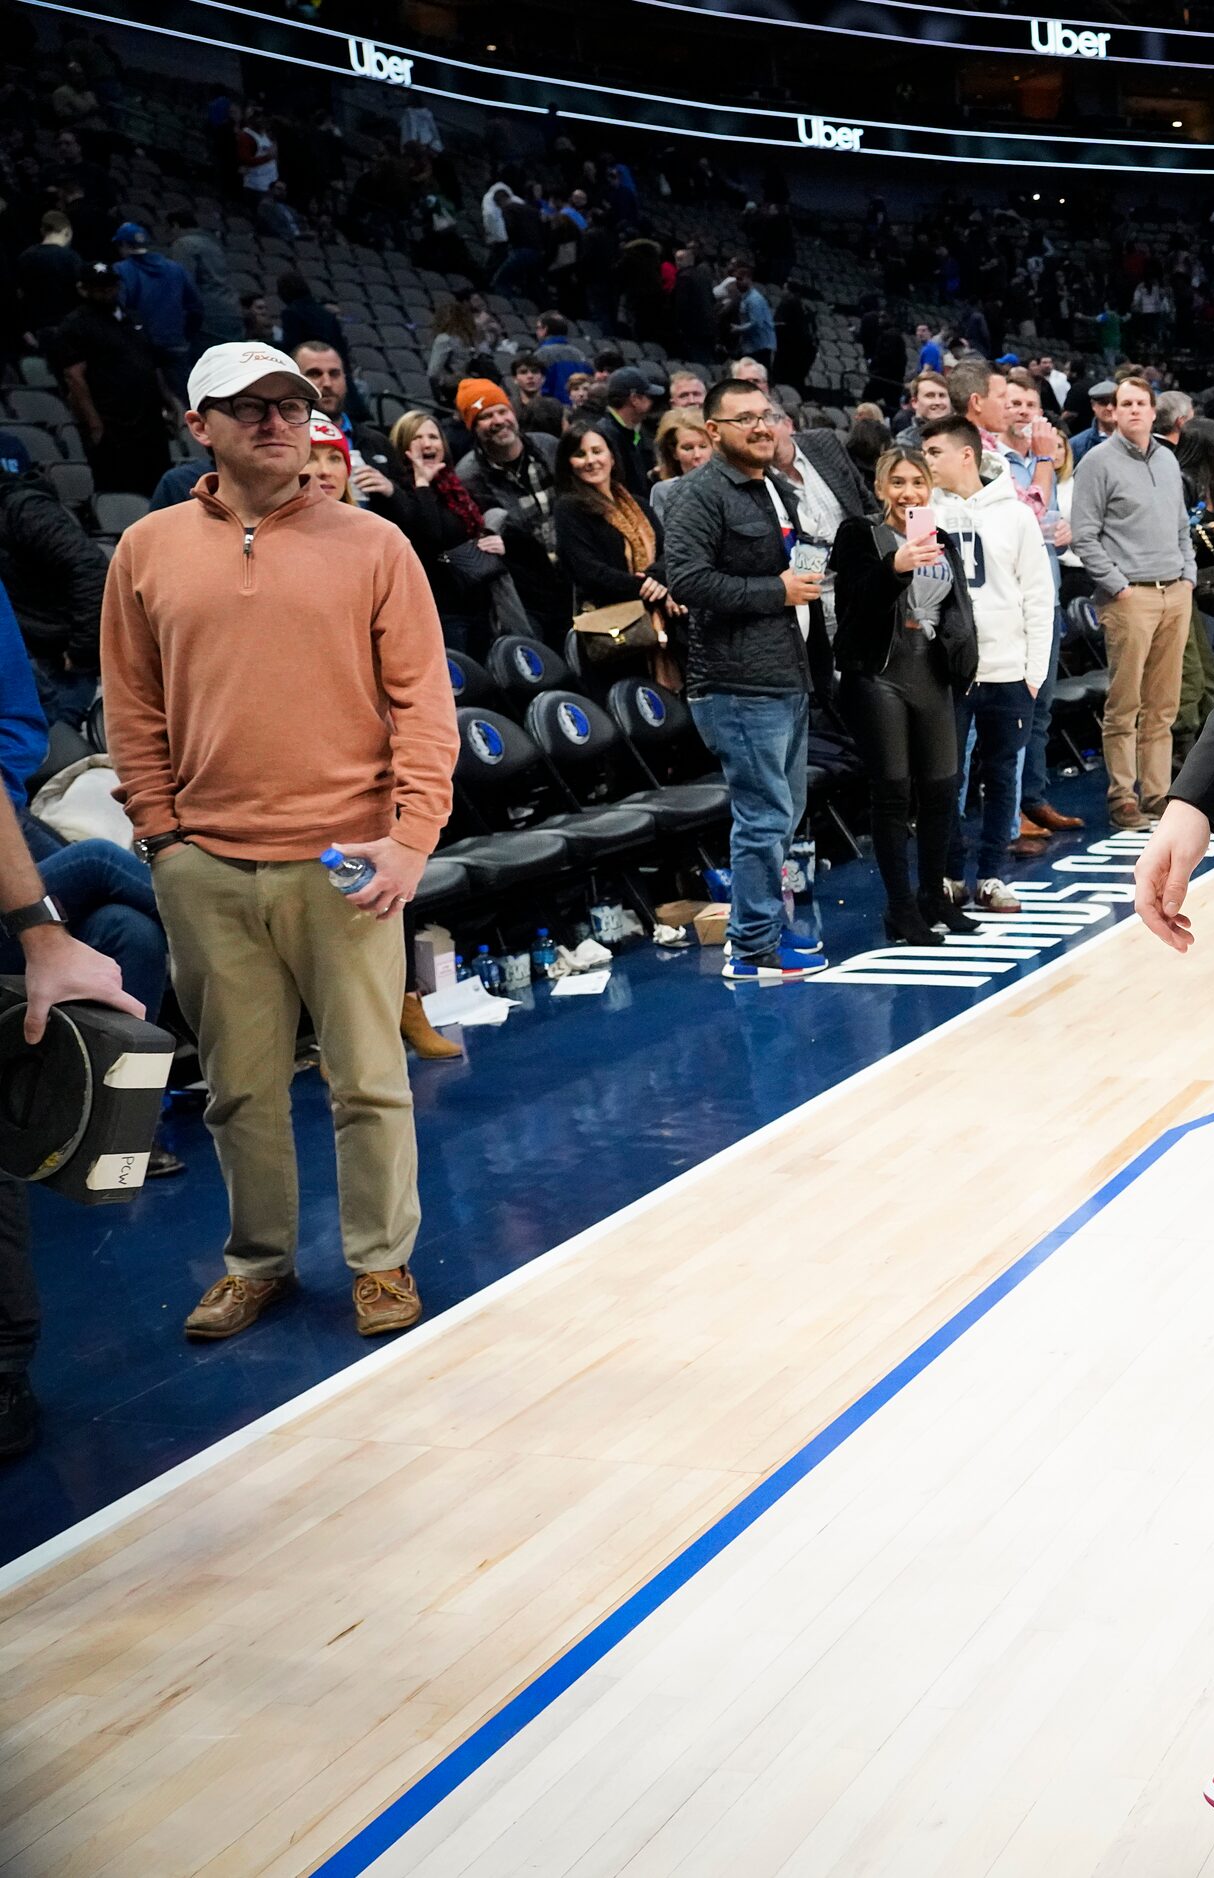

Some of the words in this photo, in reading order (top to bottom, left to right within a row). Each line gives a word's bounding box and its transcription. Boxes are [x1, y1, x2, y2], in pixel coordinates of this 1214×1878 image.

[1031, 19, 1111, 58] Uber
[348, 38, 414, 86] Uber
[797, 117, 864, 152] Uber
[240, 351, 286, 366] Texas
[118, 1156, 135, 1185] PCW
